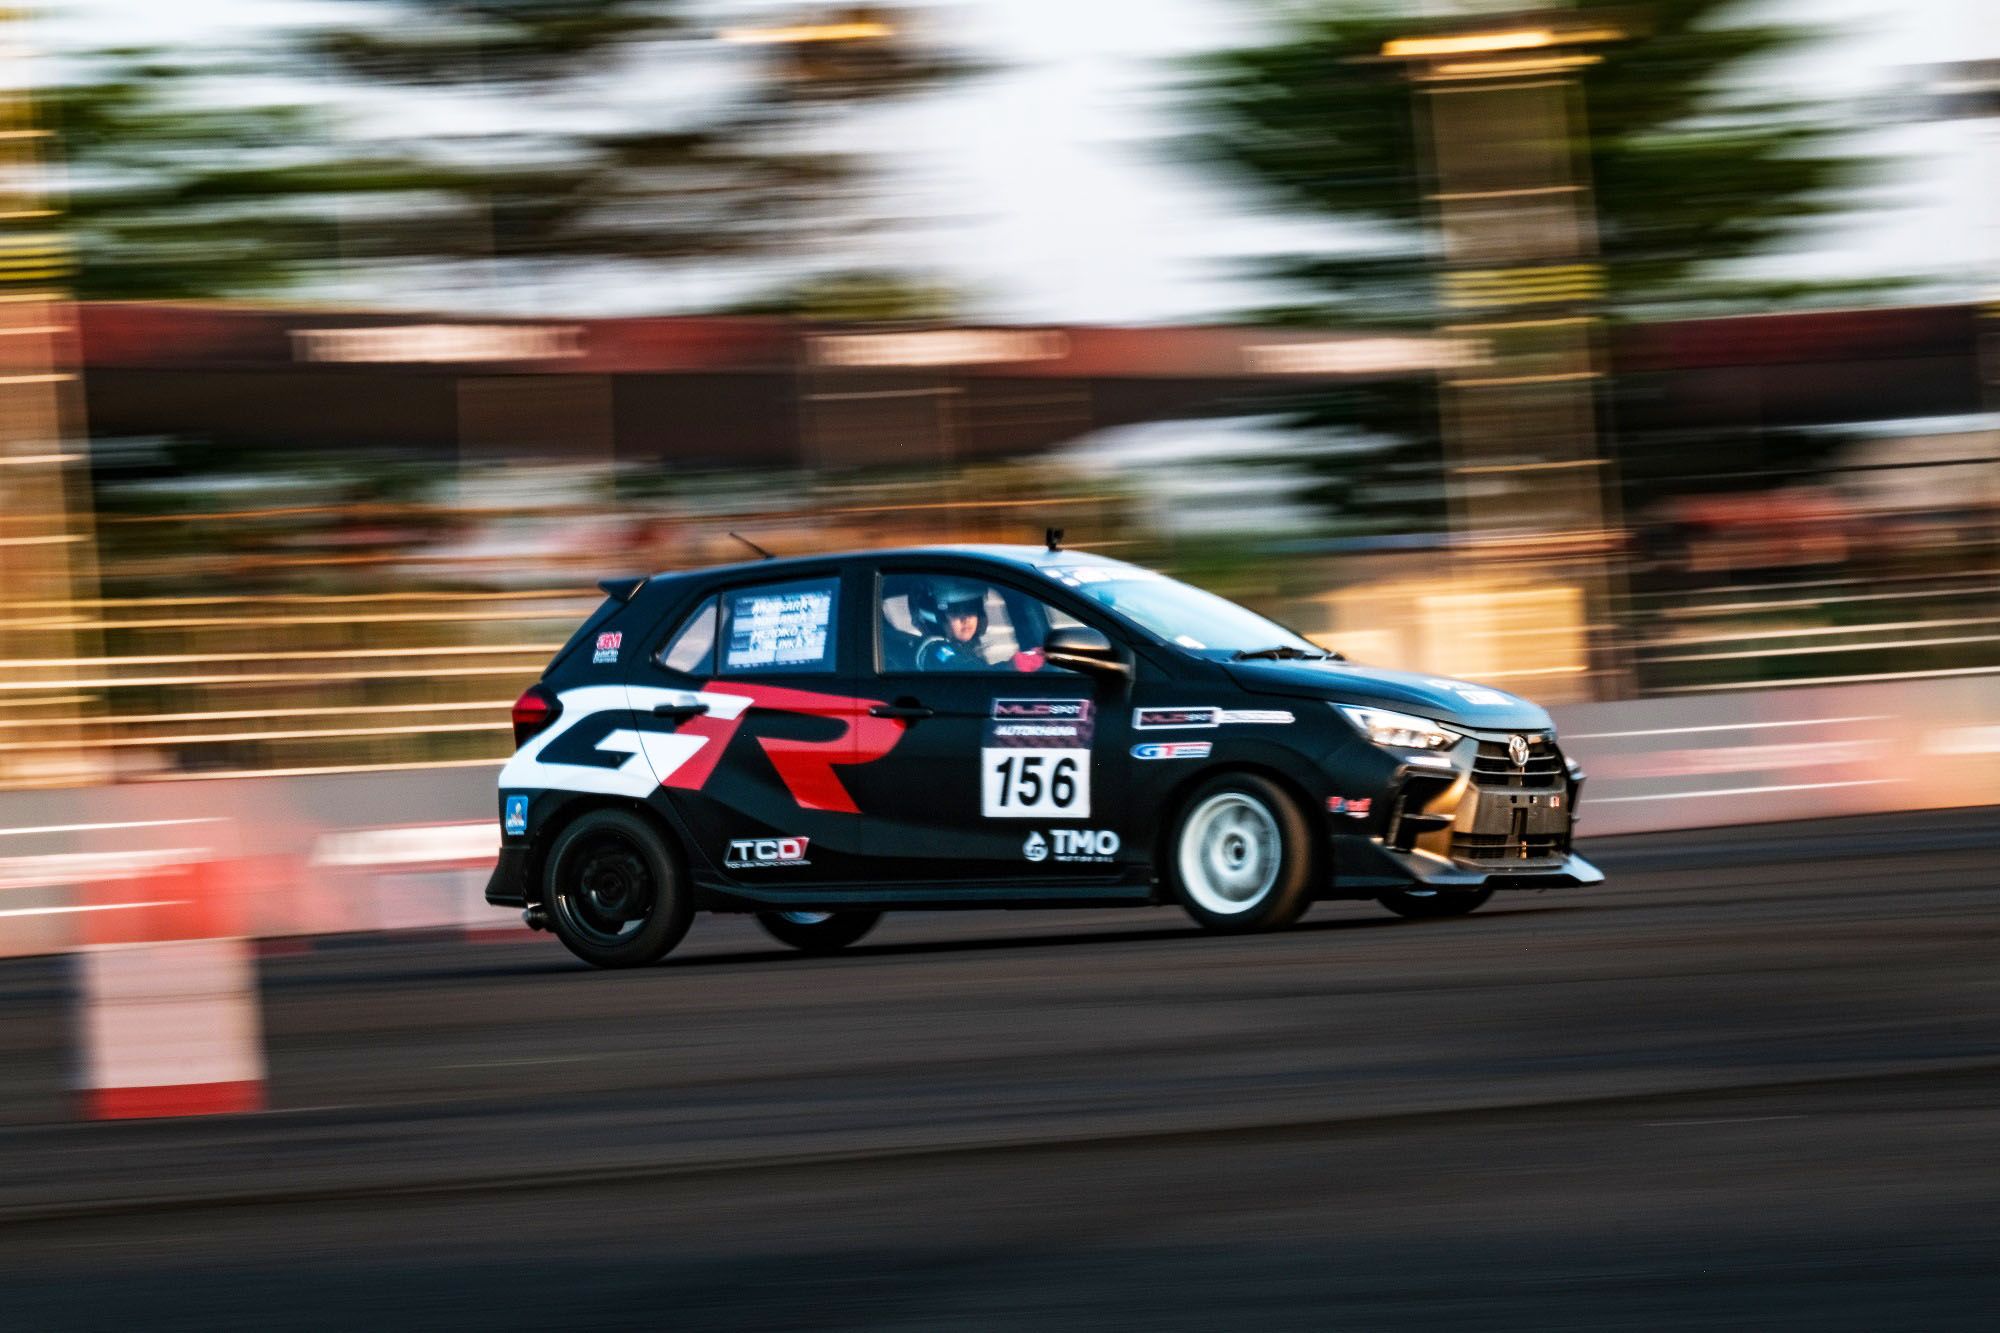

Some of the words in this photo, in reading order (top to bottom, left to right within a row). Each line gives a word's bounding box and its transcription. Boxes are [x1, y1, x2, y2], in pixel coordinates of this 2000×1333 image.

[597, 632, 622, 649] 3M
[498, 680, 908, 814] GR
[996, 756, 1078, 808] 156
[732, 841, 801, 861] TCD
[1049, 829, 1120, 855] TMO
